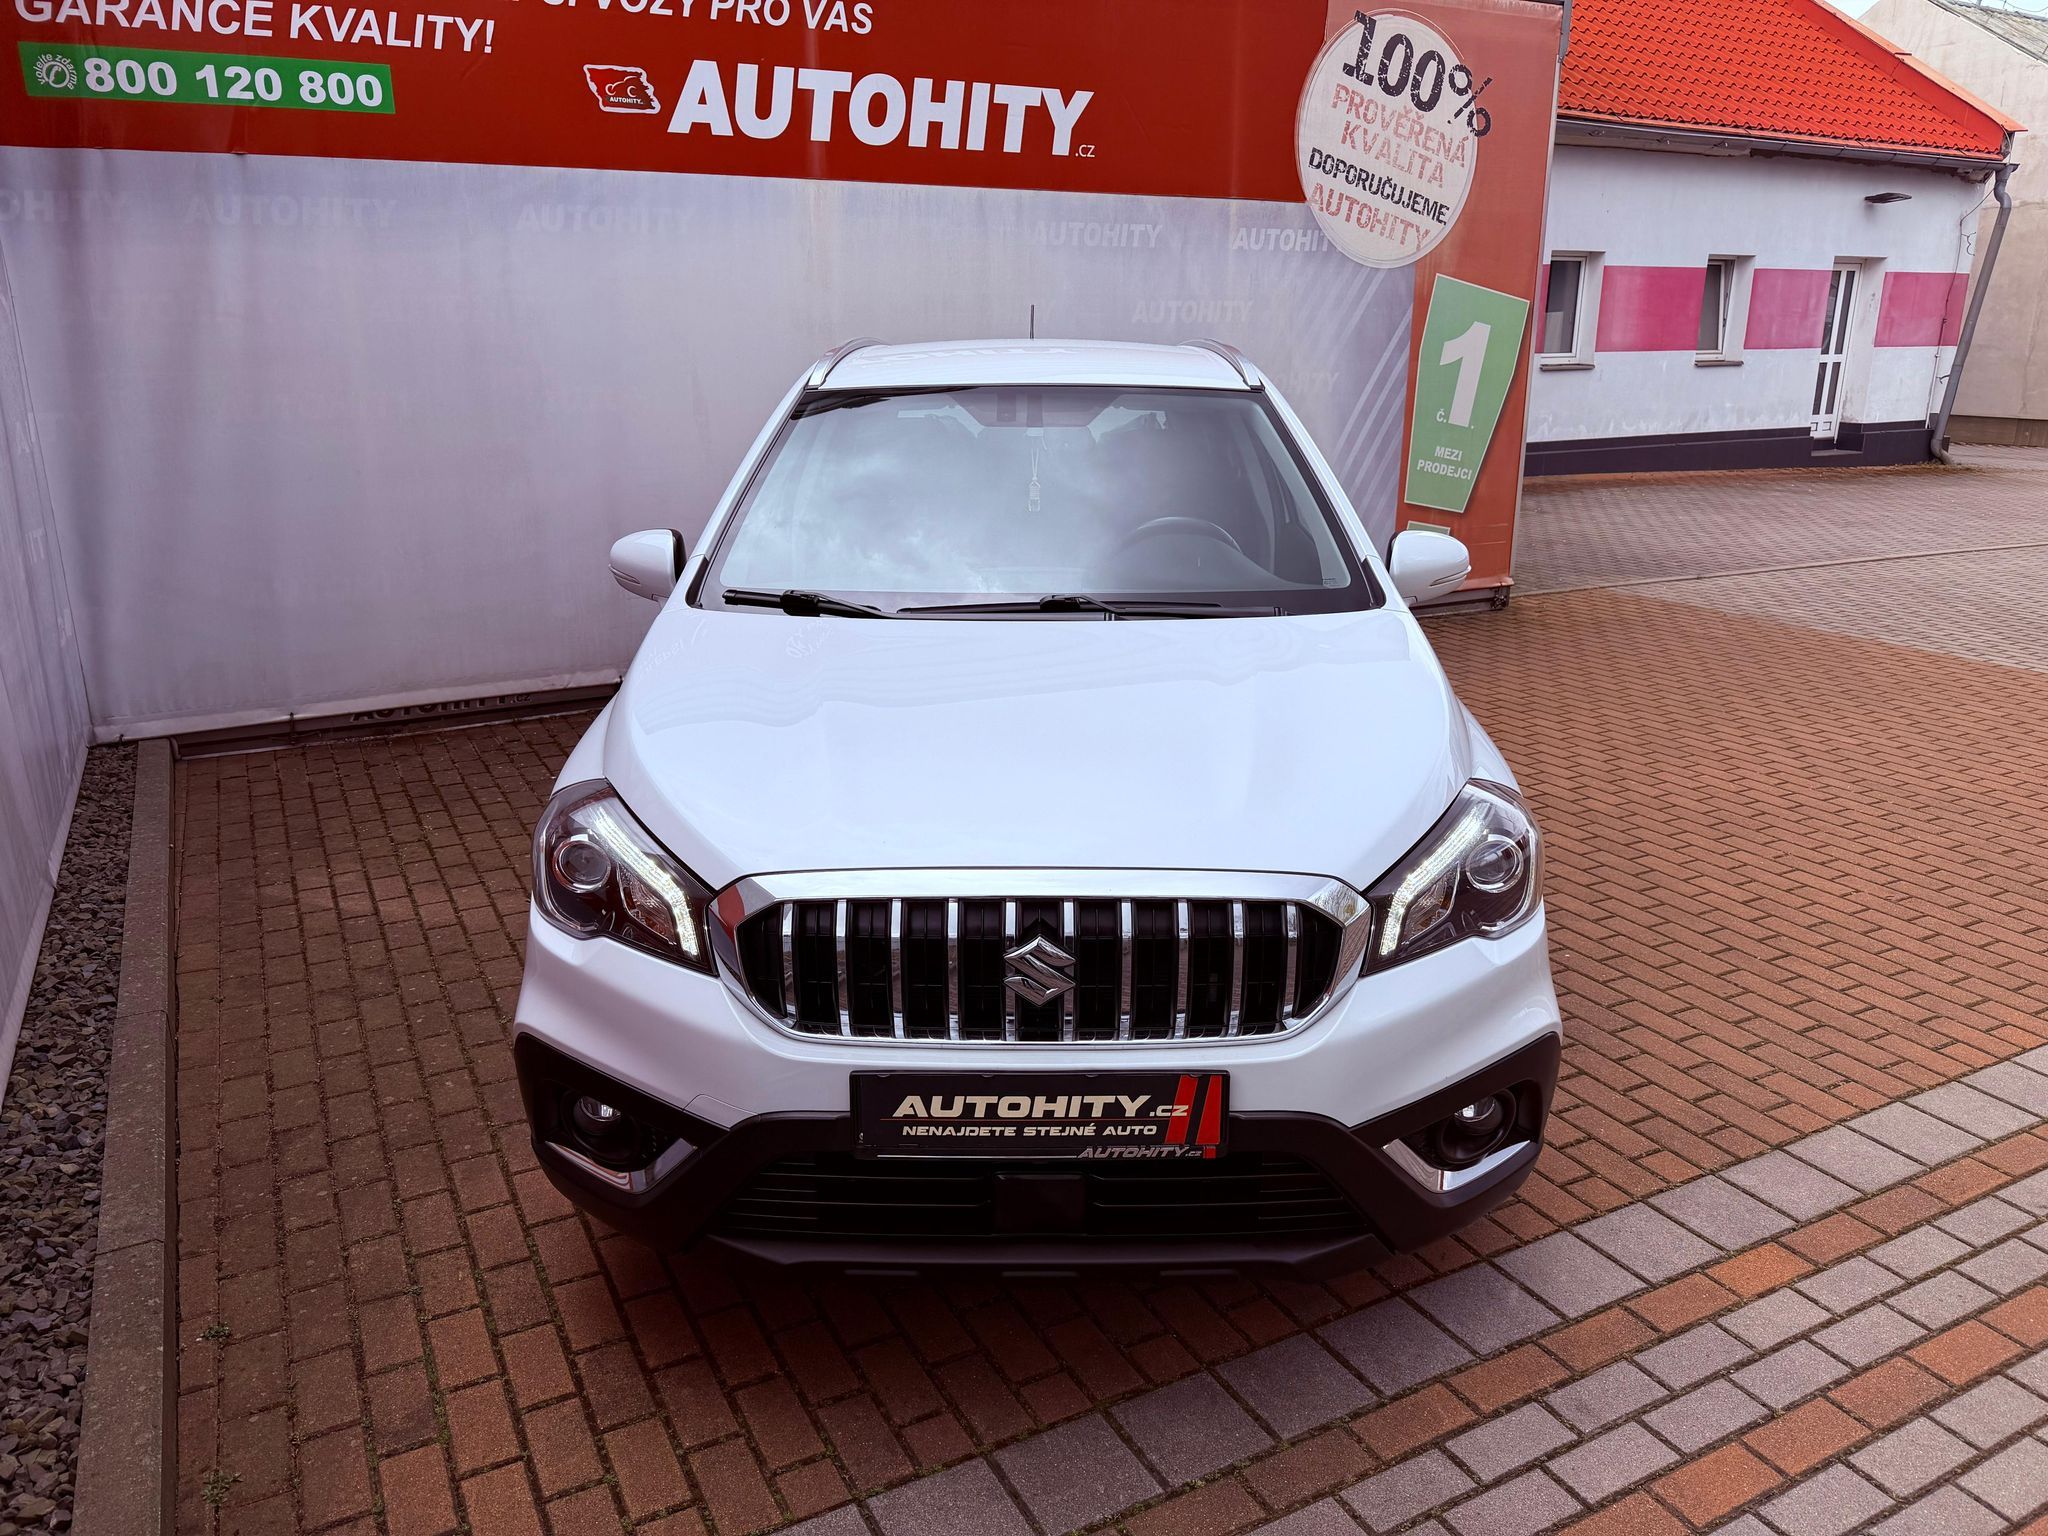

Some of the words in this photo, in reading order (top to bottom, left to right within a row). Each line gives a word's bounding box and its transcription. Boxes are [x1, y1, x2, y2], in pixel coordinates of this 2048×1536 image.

[15, 0, 273, 37] GARANCE
[290, 3, 495, 54] KVALITY!
[710, 0, 791, 27] PRO
[84, 57, 178, 97] 800
[195, 64, 282, 101] 120
[298, 70, 383, 107] 800
[1342, 10, 1493, 138] 100%
[1331, 82, 1469, 168] PROVĚŘENÁ
[1341, 119, 1445, 189] KVALITA
[1308, 147, 1450, 226] DOPORUČUJEME
[1308, 182, 1432, 252] AUTOHITY
[1416, 459, 1473, 481] PRODEJCI
[1434, 446, 1463, 462] MEZI
[902, 1125, 1016, 1137] NENAJDETE
[1023, 1123, 1097, 1137] STEJNÉ
[1102, 1125, 1157, 1136] AUTO
